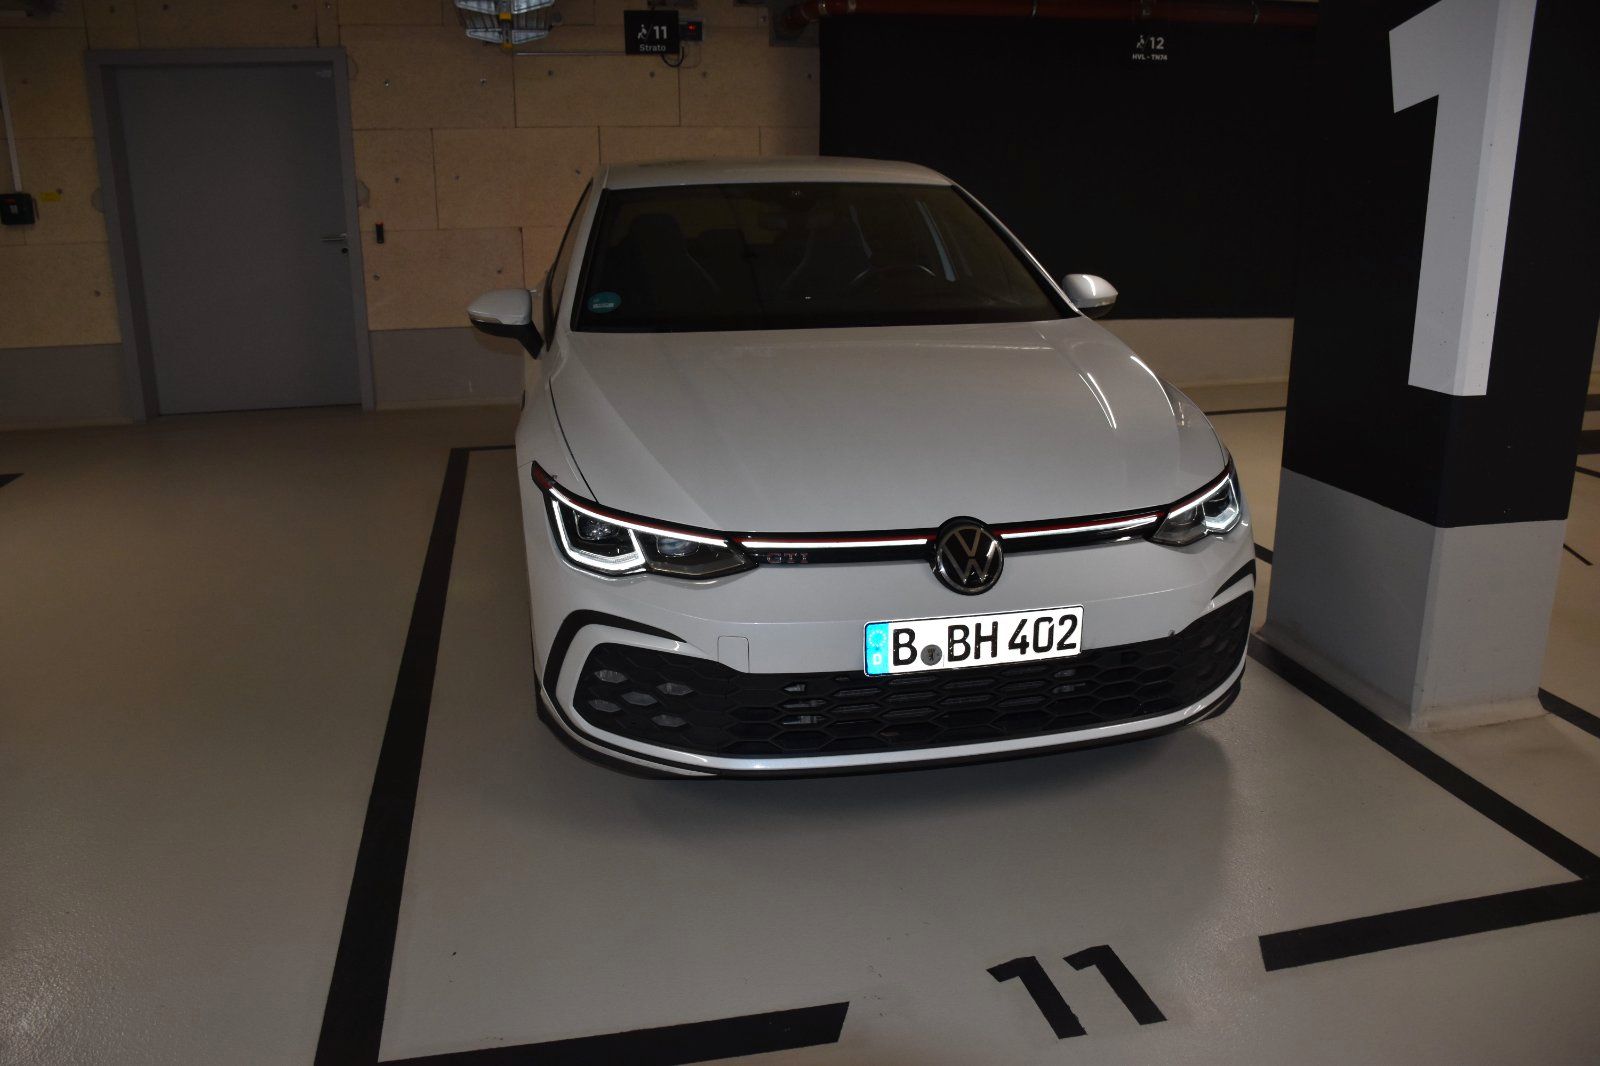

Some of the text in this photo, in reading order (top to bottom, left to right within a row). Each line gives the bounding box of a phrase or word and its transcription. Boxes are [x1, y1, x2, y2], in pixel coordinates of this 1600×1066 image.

[653, 25, 668, 40] 11
[639, 43, 666, 52] Strato
[1150, 36, 1165, 50] 12
[1388, 0, 1538, 397] 1
[766, 552, 809, 564] GTI
[892, 614, 1078, 666] B BH 402
[873, 654, 882, 666] D
[986, 945, 1167, 1039] 11
